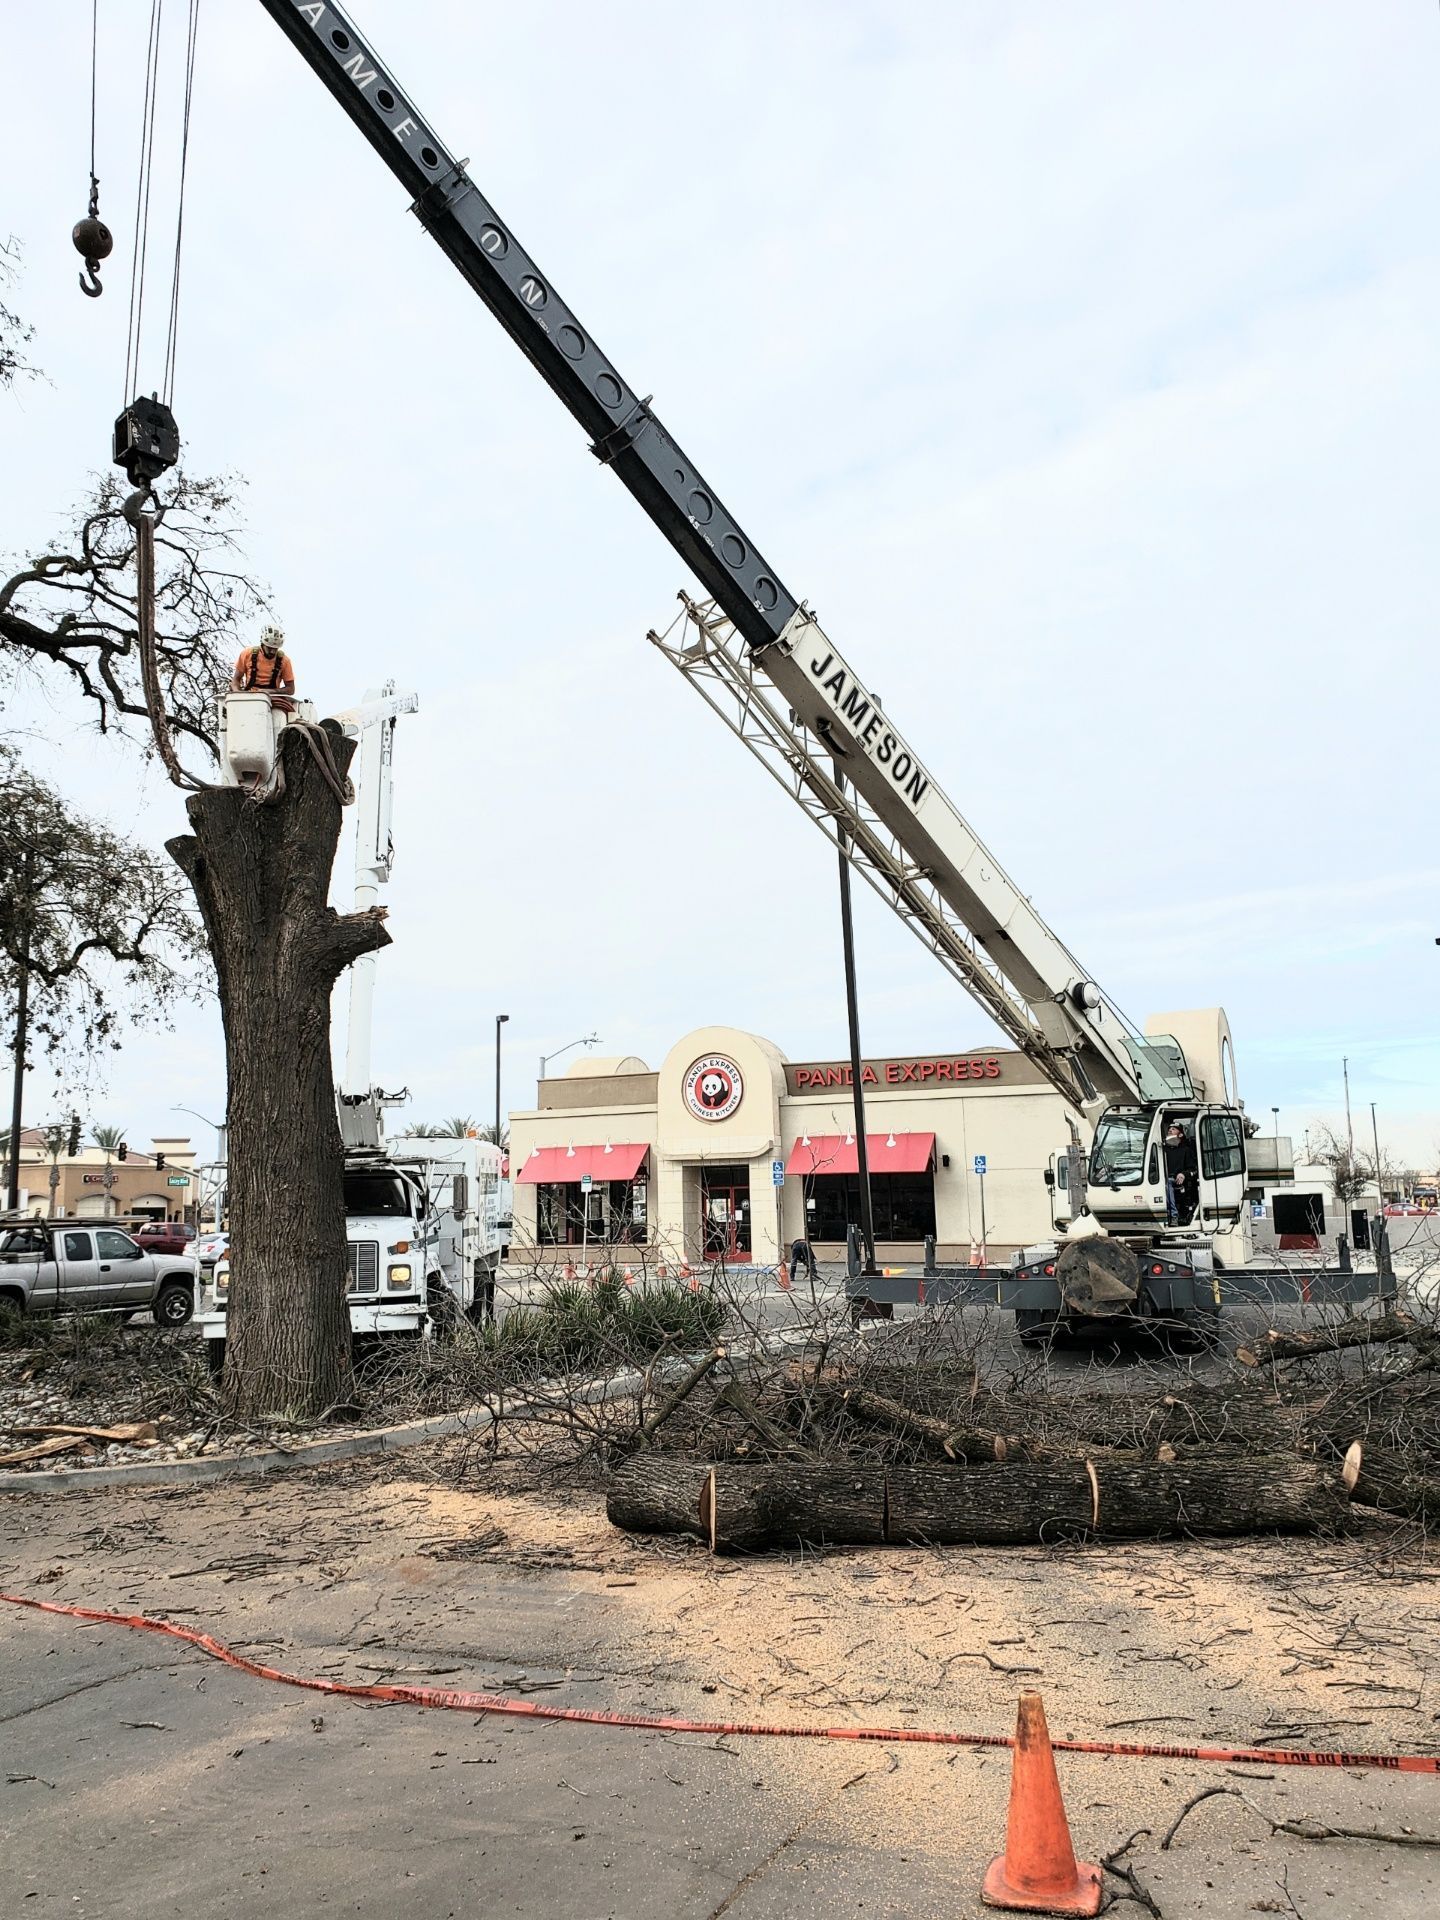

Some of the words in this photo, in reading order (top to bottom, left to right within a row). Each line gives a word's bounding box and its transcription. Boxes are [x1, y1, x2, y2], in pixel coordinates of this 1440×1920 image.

[810, 652, 929, 806] JAMESON
[687, 1062, 708, 1088] PANDA
[709, 1059, 740, 1084] EXPRESS
[885, 1057, 1000, 1084] EXPRESS
[690, 1098, 714, 1117] CHINESE
[715, 1094, 738, 1117] KITCHEN
